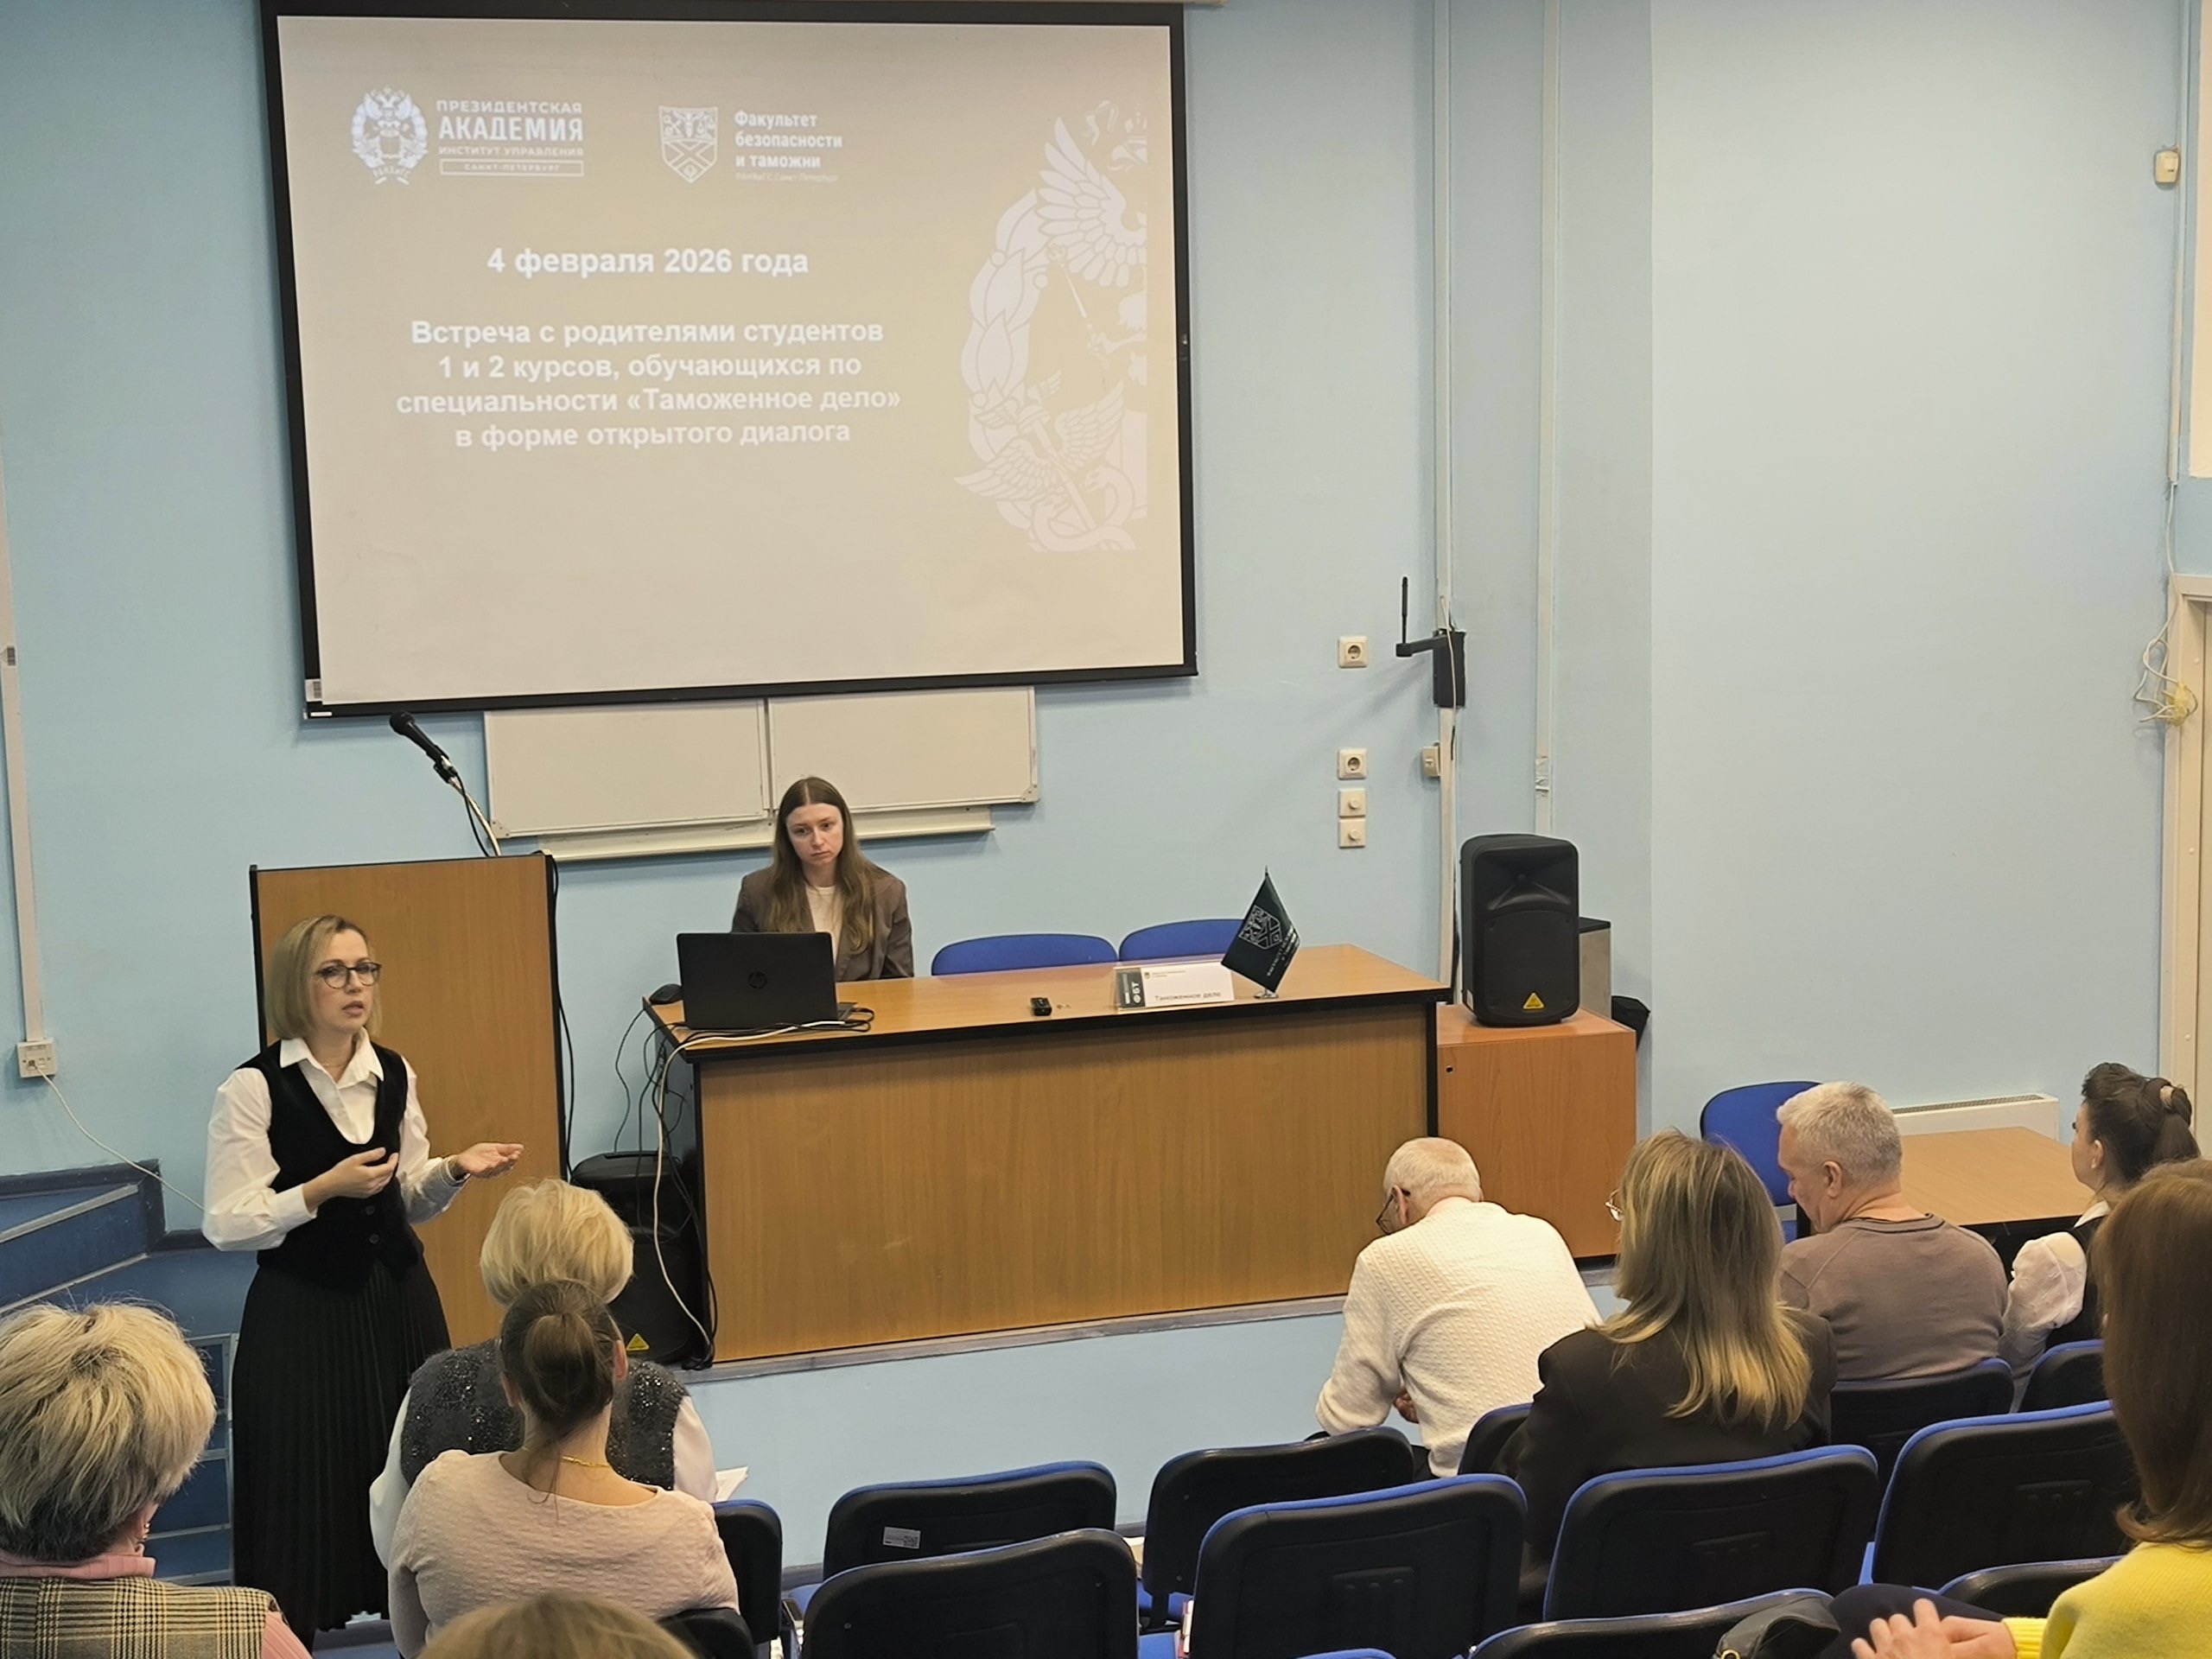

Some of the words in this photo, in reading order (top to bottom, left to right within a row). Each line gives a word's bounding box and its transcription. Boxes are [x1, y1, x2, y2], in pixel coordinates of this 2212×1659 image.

[435, 99, 582, 114] ПРЕЗИДЕНТСКАЯ
[734, 110, 818, 130] Факультет
[438, 115, 583, 142] АКАДЕМИЯ
[734, 130, 842, 148] безопасности
[438, 145, 500, 156] ИНСТИТУТ
[503, 146, 584, 157] УПРАВЛЕНИЯ
[735, 155, 746, 168] и
[749, 155, 821, 168] таможни
[486, 247, 506, 273] 4
[514, 247, 654, 279] февраля
[664, 247, 733, 273] 2026
[741, 253, 809, 277] года
[411, 320, 531, 349] Встреча
[539, 325, 556, 343] с
[563, 324, 735, 348] родителями
[743, 324, 884, 347] студентов
[439, 355, 451, 378] 1
[462, 360, 480, 378] и
[488, 355, 505, 378] 2
[513, 359, 620, 383] курсов,
[628, 353, 821, 382] обучающихся
[829, 358, 861, 375] по
[397, 393, 618, 416] специальности
[626, 387, 813, 410] «Таможенное
[819, 391, 900, 412] дело»
[455, 429, 473, 448] в
[480, 423, 579, 452] форме
[587, 426, 734, 449] открытого
[739, 424, 850, 447] диалога
